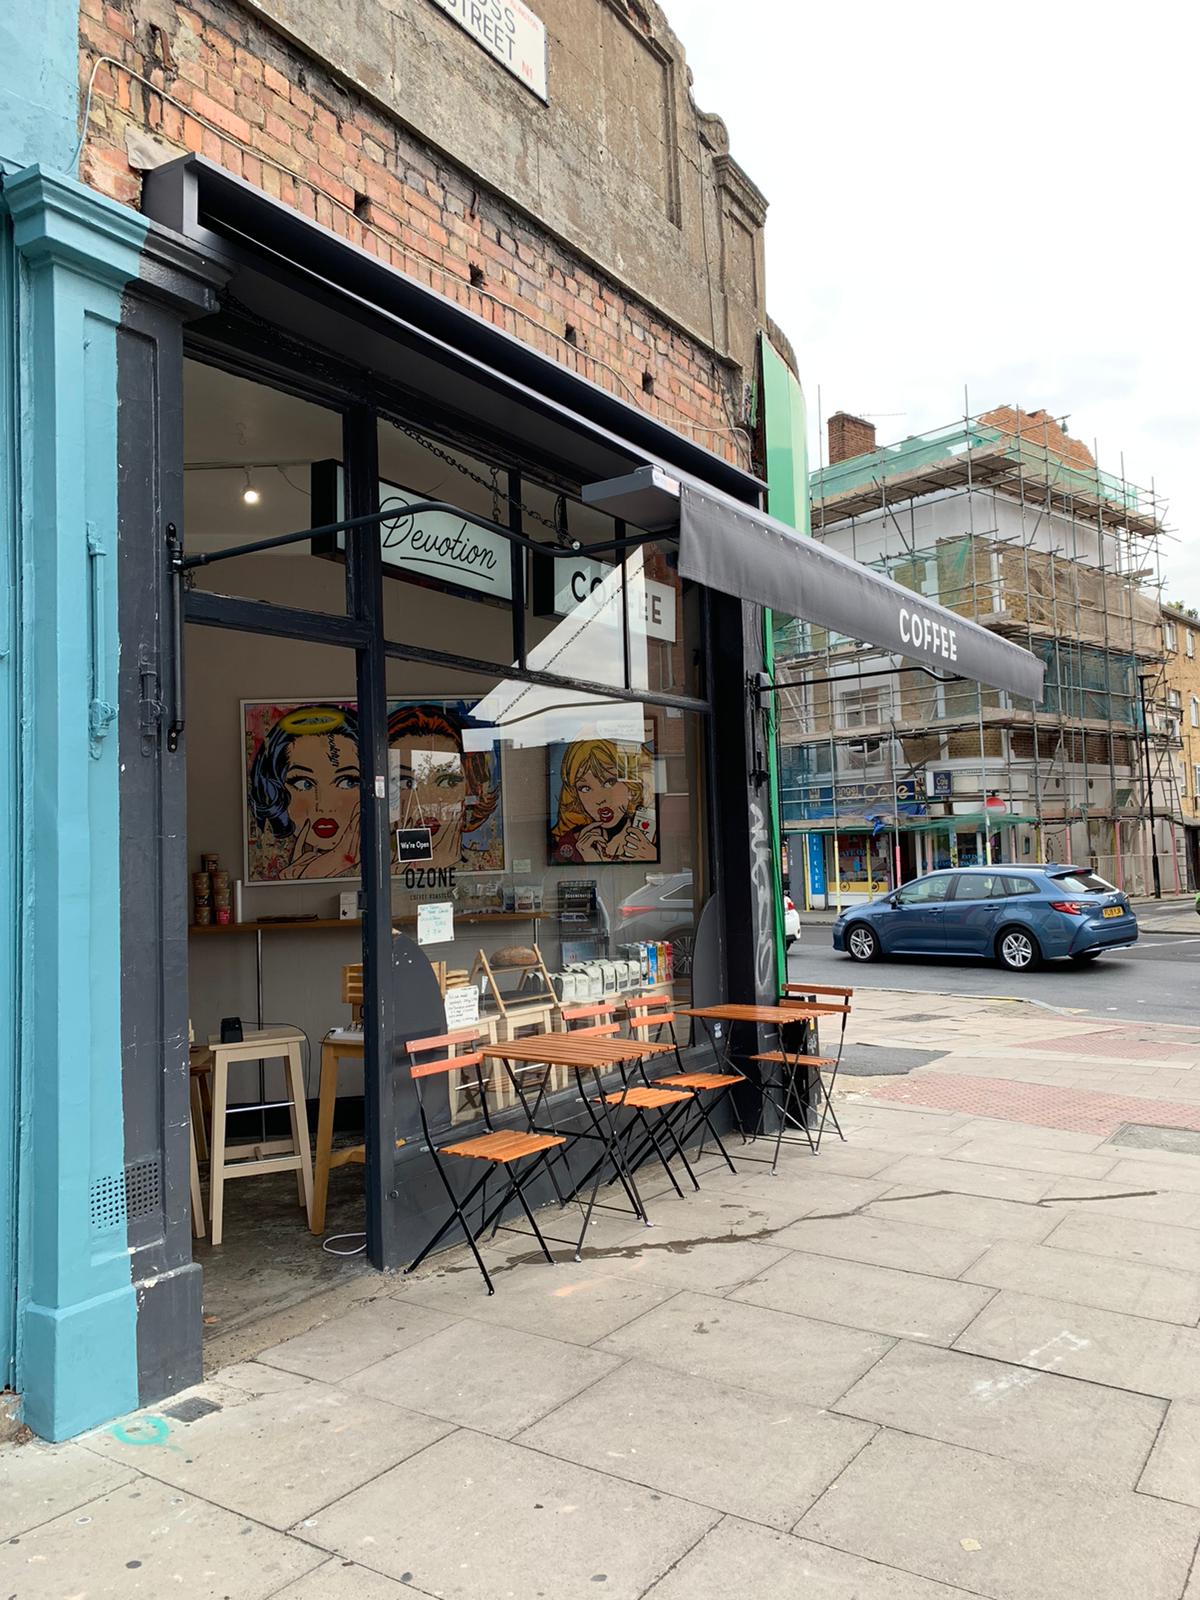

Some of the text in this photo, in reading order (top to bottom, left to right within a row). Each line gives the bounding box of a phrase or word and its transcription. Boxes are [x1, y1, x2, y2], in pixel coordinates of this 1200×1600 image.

[521, 60, 533, 80] N1
[380, 497, 497, 569] Devotion
[899, 608, 957, 661] COFFEE
[416, 841, 429, 849] Open
[405, 867, 457, 889] OZONE
